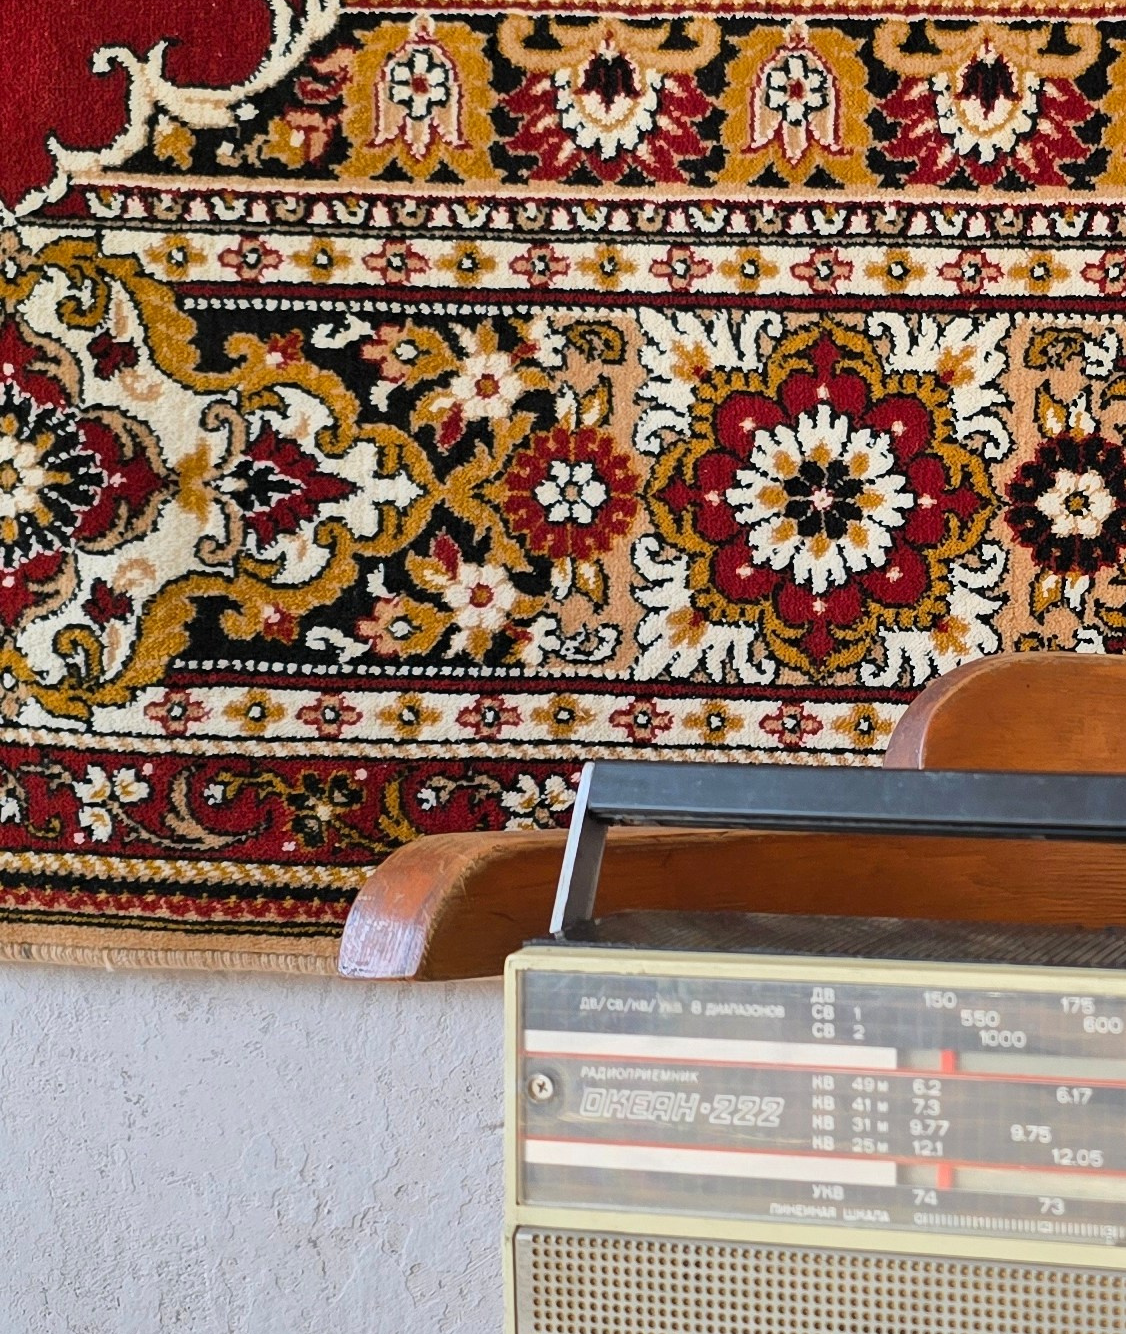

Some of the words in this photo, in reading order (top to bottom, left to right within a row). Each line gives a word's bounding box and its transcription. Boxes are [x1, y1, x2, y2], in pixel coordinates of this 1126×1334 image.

[810, 987, 835, 1004] ДВ
[924, 991, 957, 1009] 150
[1061, 997, 1096, 1015] 175
[812, 1005, 835, 1020] СВ
[854, 1007, 861, 1021] 1
[960, 1009, 1000, 1027] 550
[812, 1023, 835, 1038] СВ
[853, 1024, 865, 1040] 2
[979, 1030, 1026, 1048] 1000
[581, 1067, 699, 1084] РАДИОПРИЕМНИК
[852, 1077, 875, 1093] 49
[912, 1079, 942, 1096] 6.2
[1056, 1087, 1093, 1104] 6.17
[852, 1097, 871, 1113] 41
[912, 1099, 941, 1116] 7.3
[852, 1117, 871, 1133] 31
[852, 1138, 876, 1154] 25
[1052, 1148, 1103, 1167] 12.05
[812, 1184, 844, 1200] УКВ
[912, 1189, 938, 1206] 74
[1039, 1197, 1065, 1215] 73
